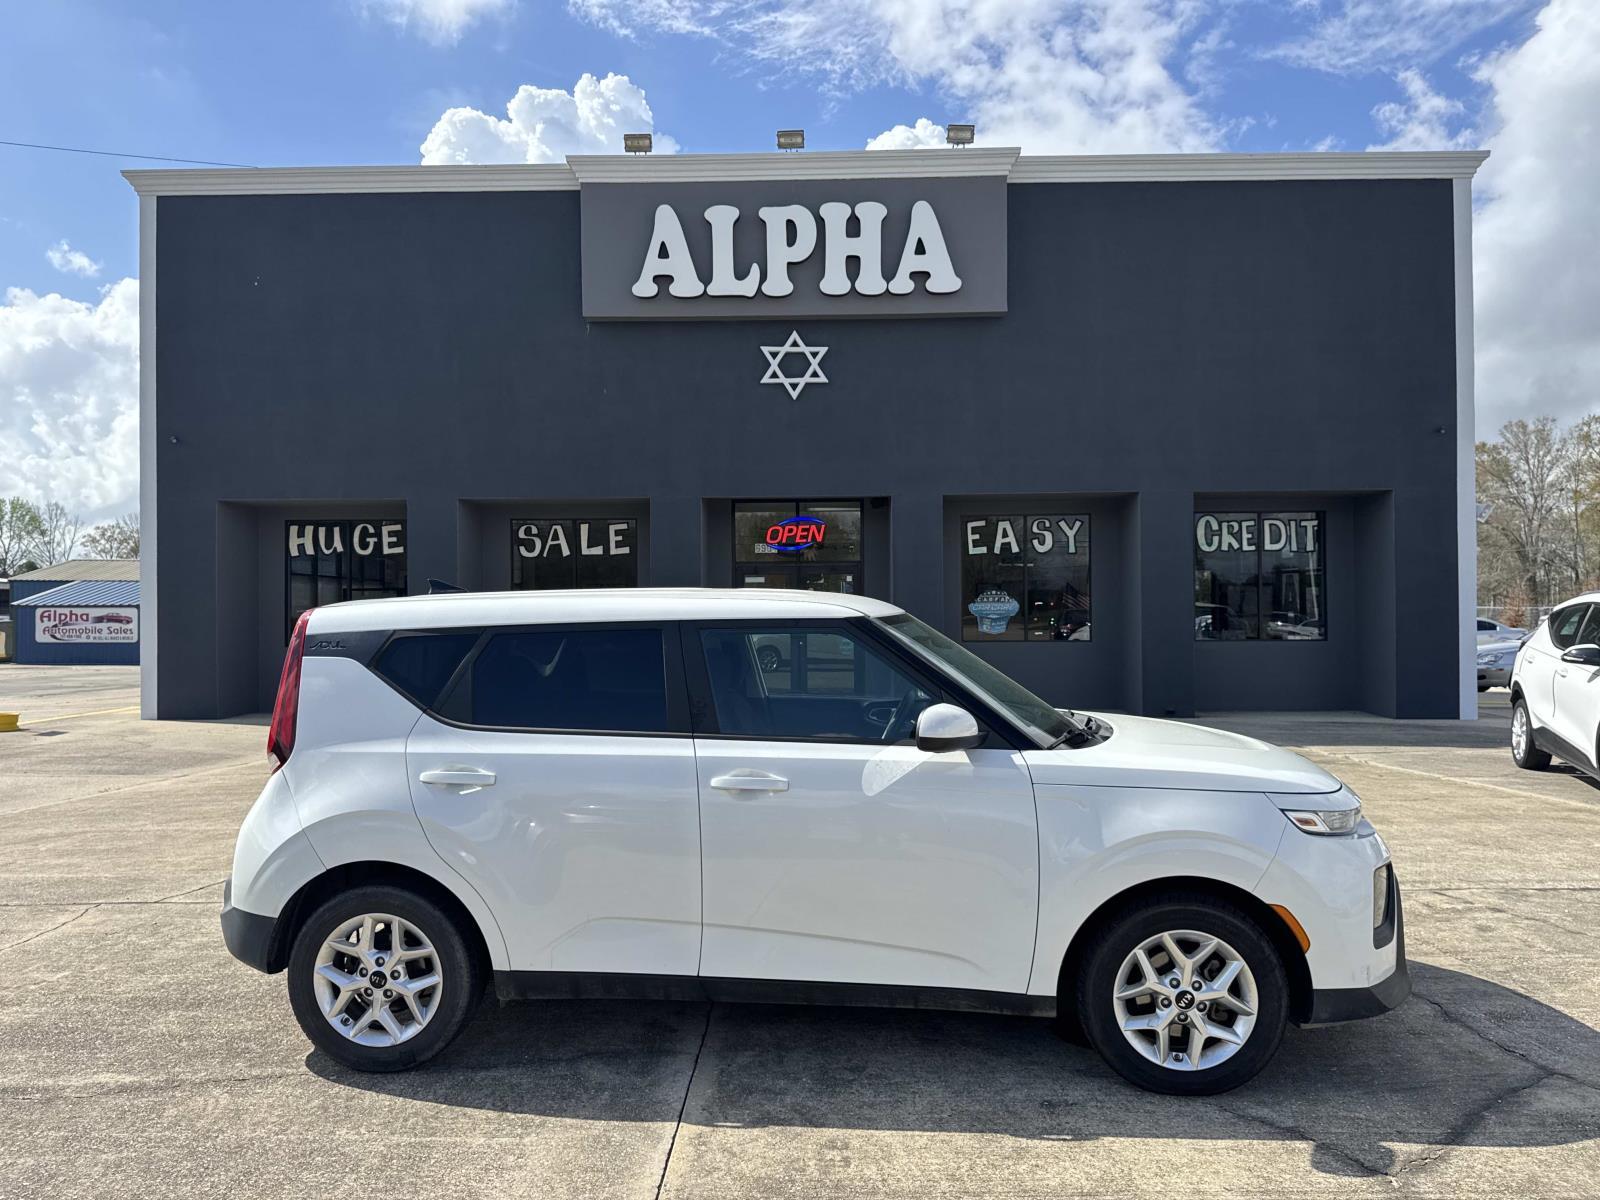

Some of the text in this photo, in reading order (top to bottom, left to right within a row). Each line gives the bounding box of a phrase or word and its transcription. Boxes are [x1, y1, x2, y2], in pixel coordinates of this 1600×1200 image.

[631, 200, 962, 298] ALPHA
[288, 523, 404, 557] HUGE
[518, 523, 630, 558] SALE
[755, 543, 778, 554] 690
[766, 524, 826, 544] OPEN
[966, 518, 1082, 555] EASY
[1196, 515, 1318, 552] CREDIT
[39, 610, 90, 625] Alpha
[42, 626, 134, 636] Automobile Sales
